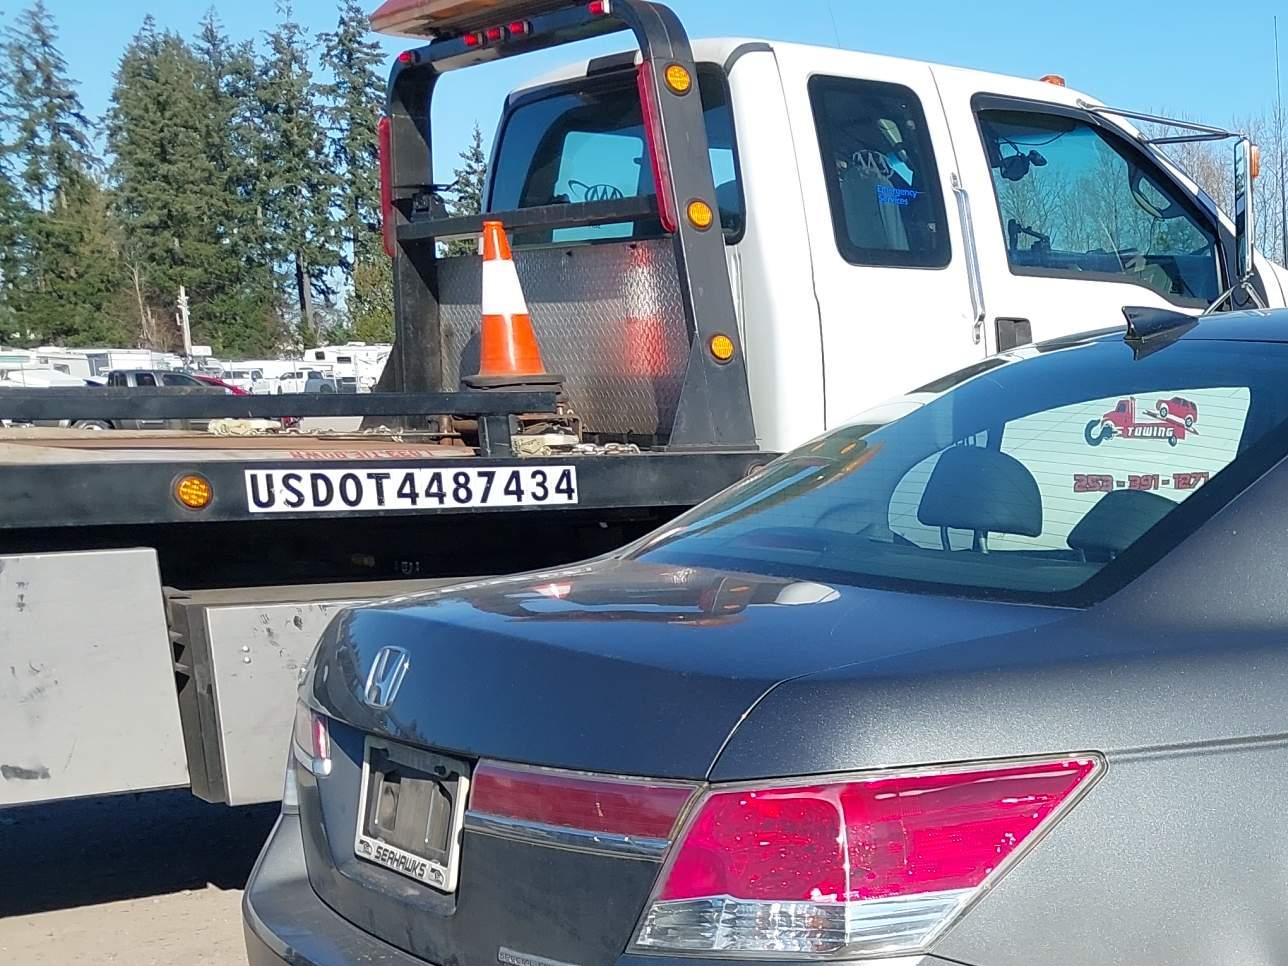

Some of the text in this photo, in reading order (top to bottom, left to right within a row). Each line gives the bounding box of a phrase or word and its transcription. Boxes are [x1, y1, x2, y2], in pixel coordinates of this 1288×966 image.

[1127, 426, 1174, 437] TOWING
[250, 470, 575, 508] USDOT4487434
[1074, 474, 1113, 492] 253
[1128, 474, 1159, 490] 391
[374, 846, 427, 878] SEAHAWKS
